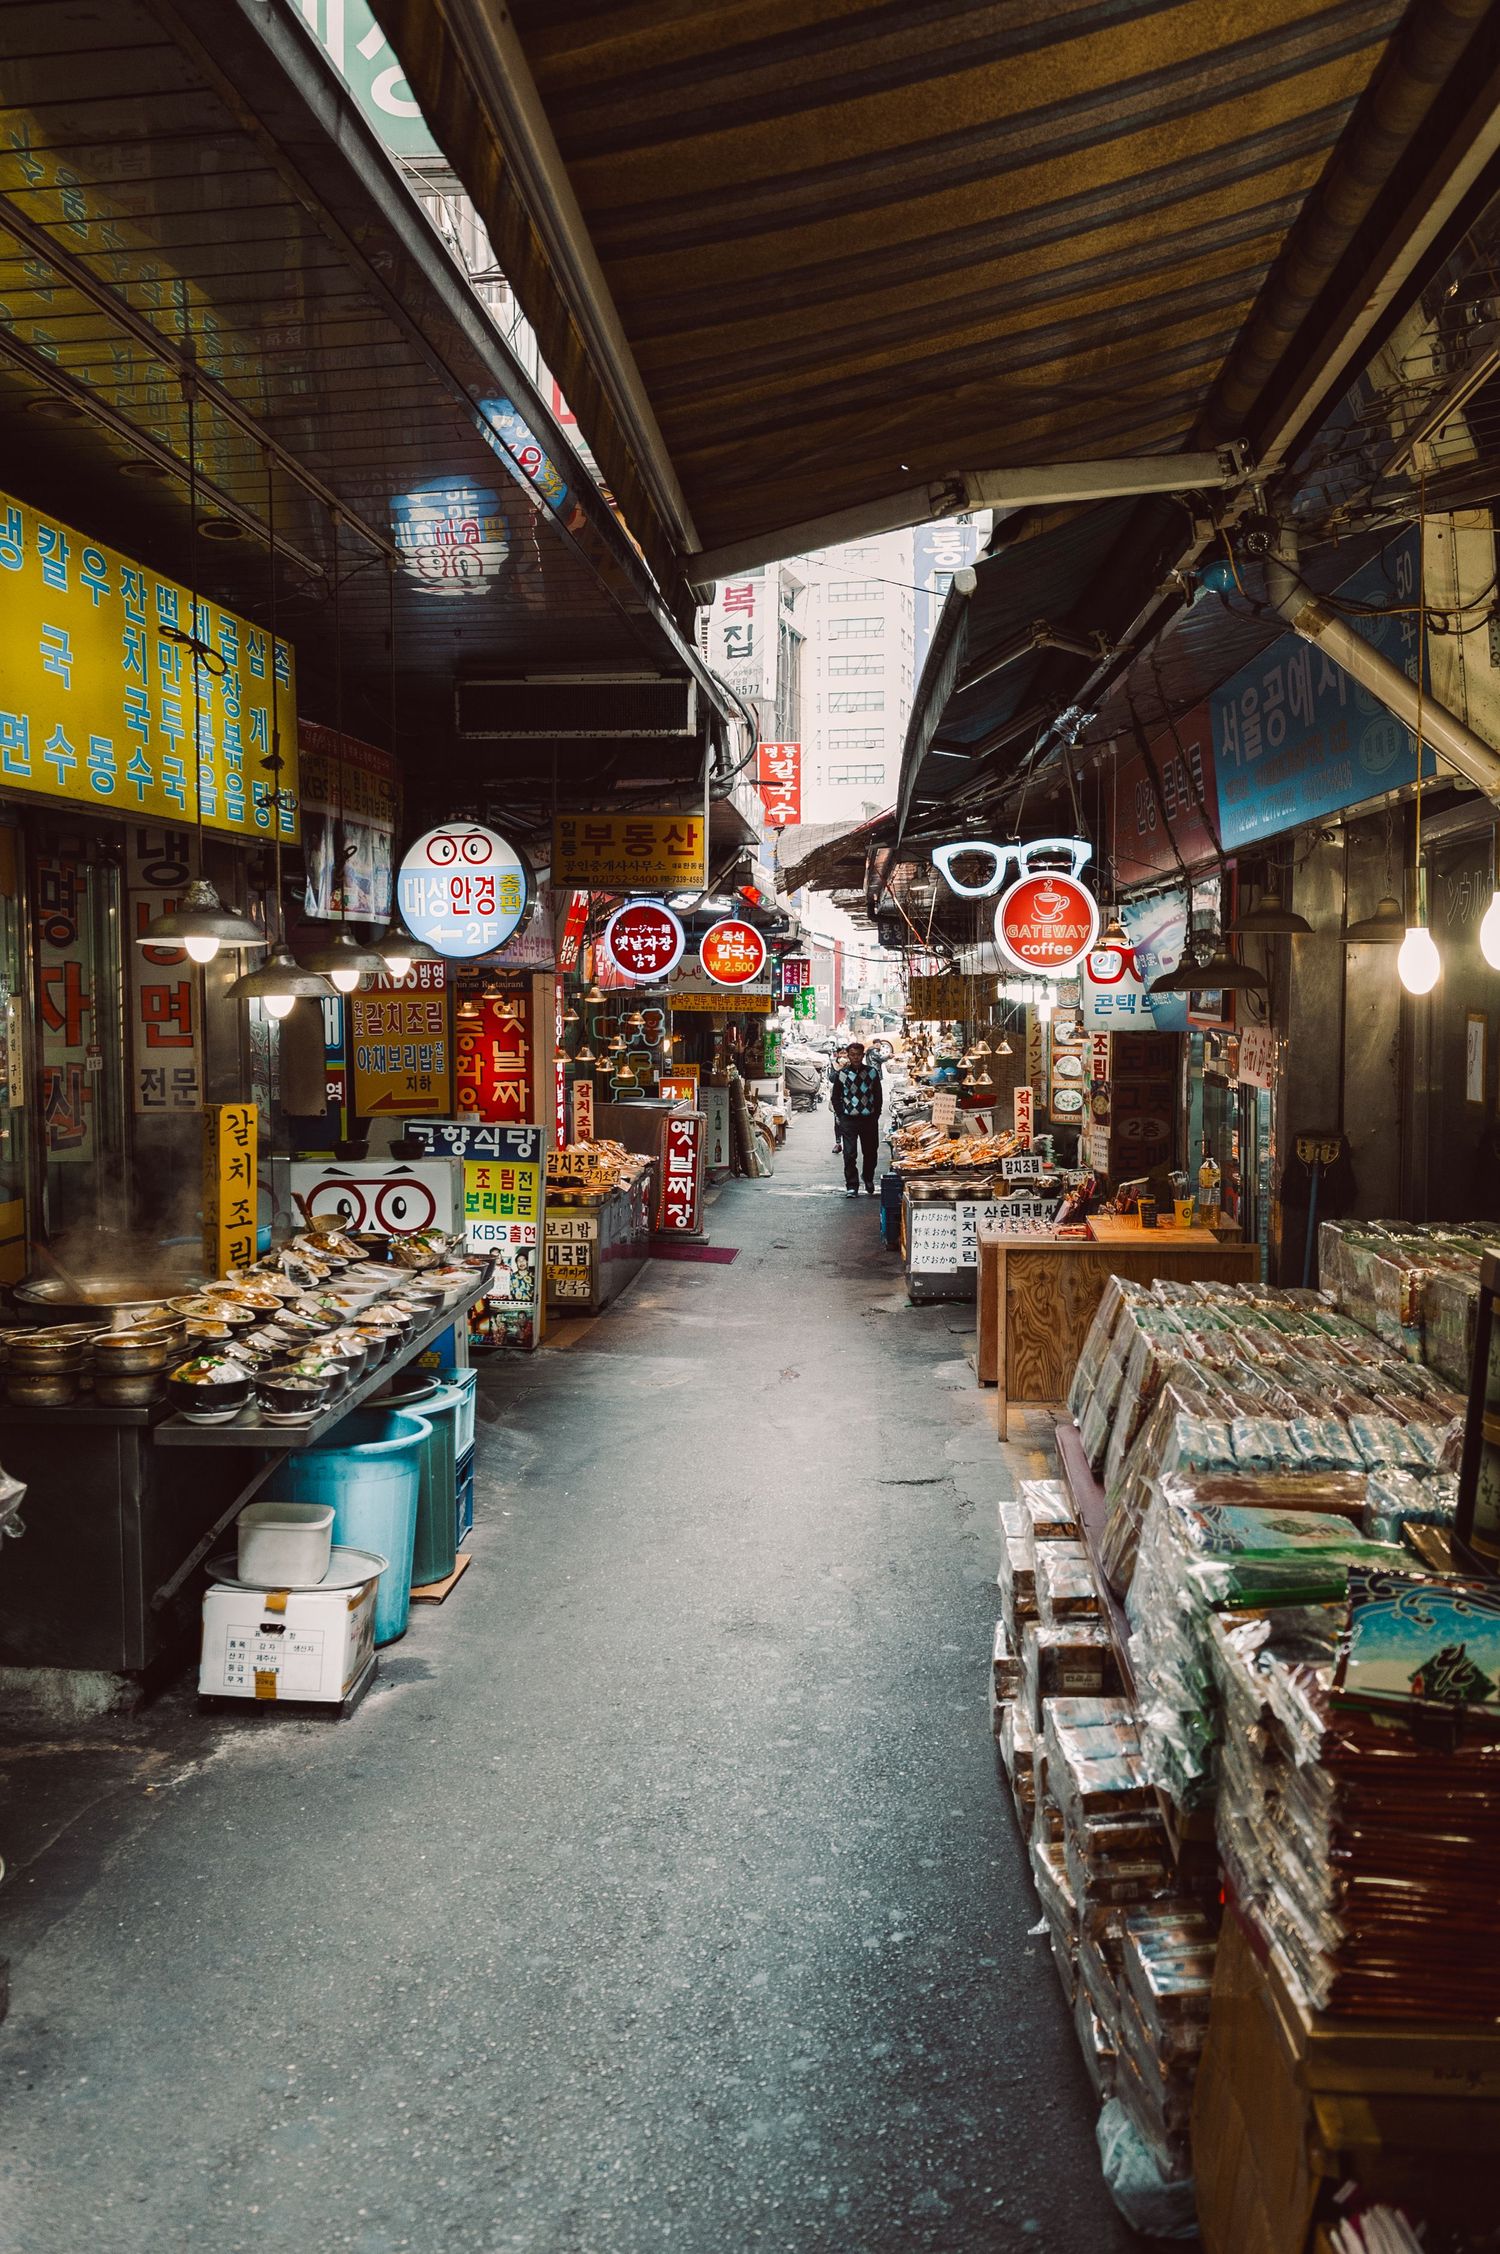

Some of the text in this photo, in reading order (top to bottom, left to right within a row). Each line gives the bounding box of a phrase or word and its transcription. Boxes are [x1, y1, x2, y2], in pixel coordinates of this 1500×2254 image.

[37, 523, 78, 786] 칼국수
[80, 546, 118, 794] 우동
[119, 565, 155, 802] 잔치국수
[155, 583, 186, 811] 떡만두국
[187, 602, 217, 817] 제육볶음
[218, 613, 246, 823] 곱창볶음
[246, 628, 272, 828] 삼계탕
[764, 746, 797, 758] 명동
[767, 759, 798, 823] 칼국수
[581, 824, 698, 857] 부동산
[466, 922, 499, 944] 2F
[615, 935, 674, 951] 옛날자장
[722, 931, 746, 943] 즉석
[1006, 924, 1089, 940] GATEWAY
[632, 953, 657, 968] 남경
[717, 944, 760, 960] 칼국수
[1020, 942, 1073, 957] coffee
[420, 963, 444, 989] 방영
[354, 1001, 364, 1038] 원조
[366, 1001, 444, 1036] 갈치조림
[357, 1044, 433, 1075] 야채보리밥
[434, 1041, 445, 1074] 전문
[1093, 1034, 1107, 1081] 조림
[141, 1067, 198, 1107] 전문
[406, 1074, 431, 1092] 지하
[576, 1084, 592, 1141] 갈치조림
[1017, 1090, 1032, 1149] 갈치조림
[409, 1126, 536, 1157] 고향식당
[1128, 1121, 1160, 1138] 2층
[667, 1120, 695, 1228] 옛날짜장
[1005, 1159, 1040, 1175] 갈치조림
[224, 1109, 256, 1273] 갈치조림
[517, 1171, 533, 1215] 전문
[1000, 1203, 1043, 1218] 순대국밥
[473, 1225, 536, 1244] KBS 출연
[545, 1221, 591, 1238] 보리밥
[962, 1206, 977, 1262] 갈치조림
[547, 1245, 587, 1265] 대국밥
